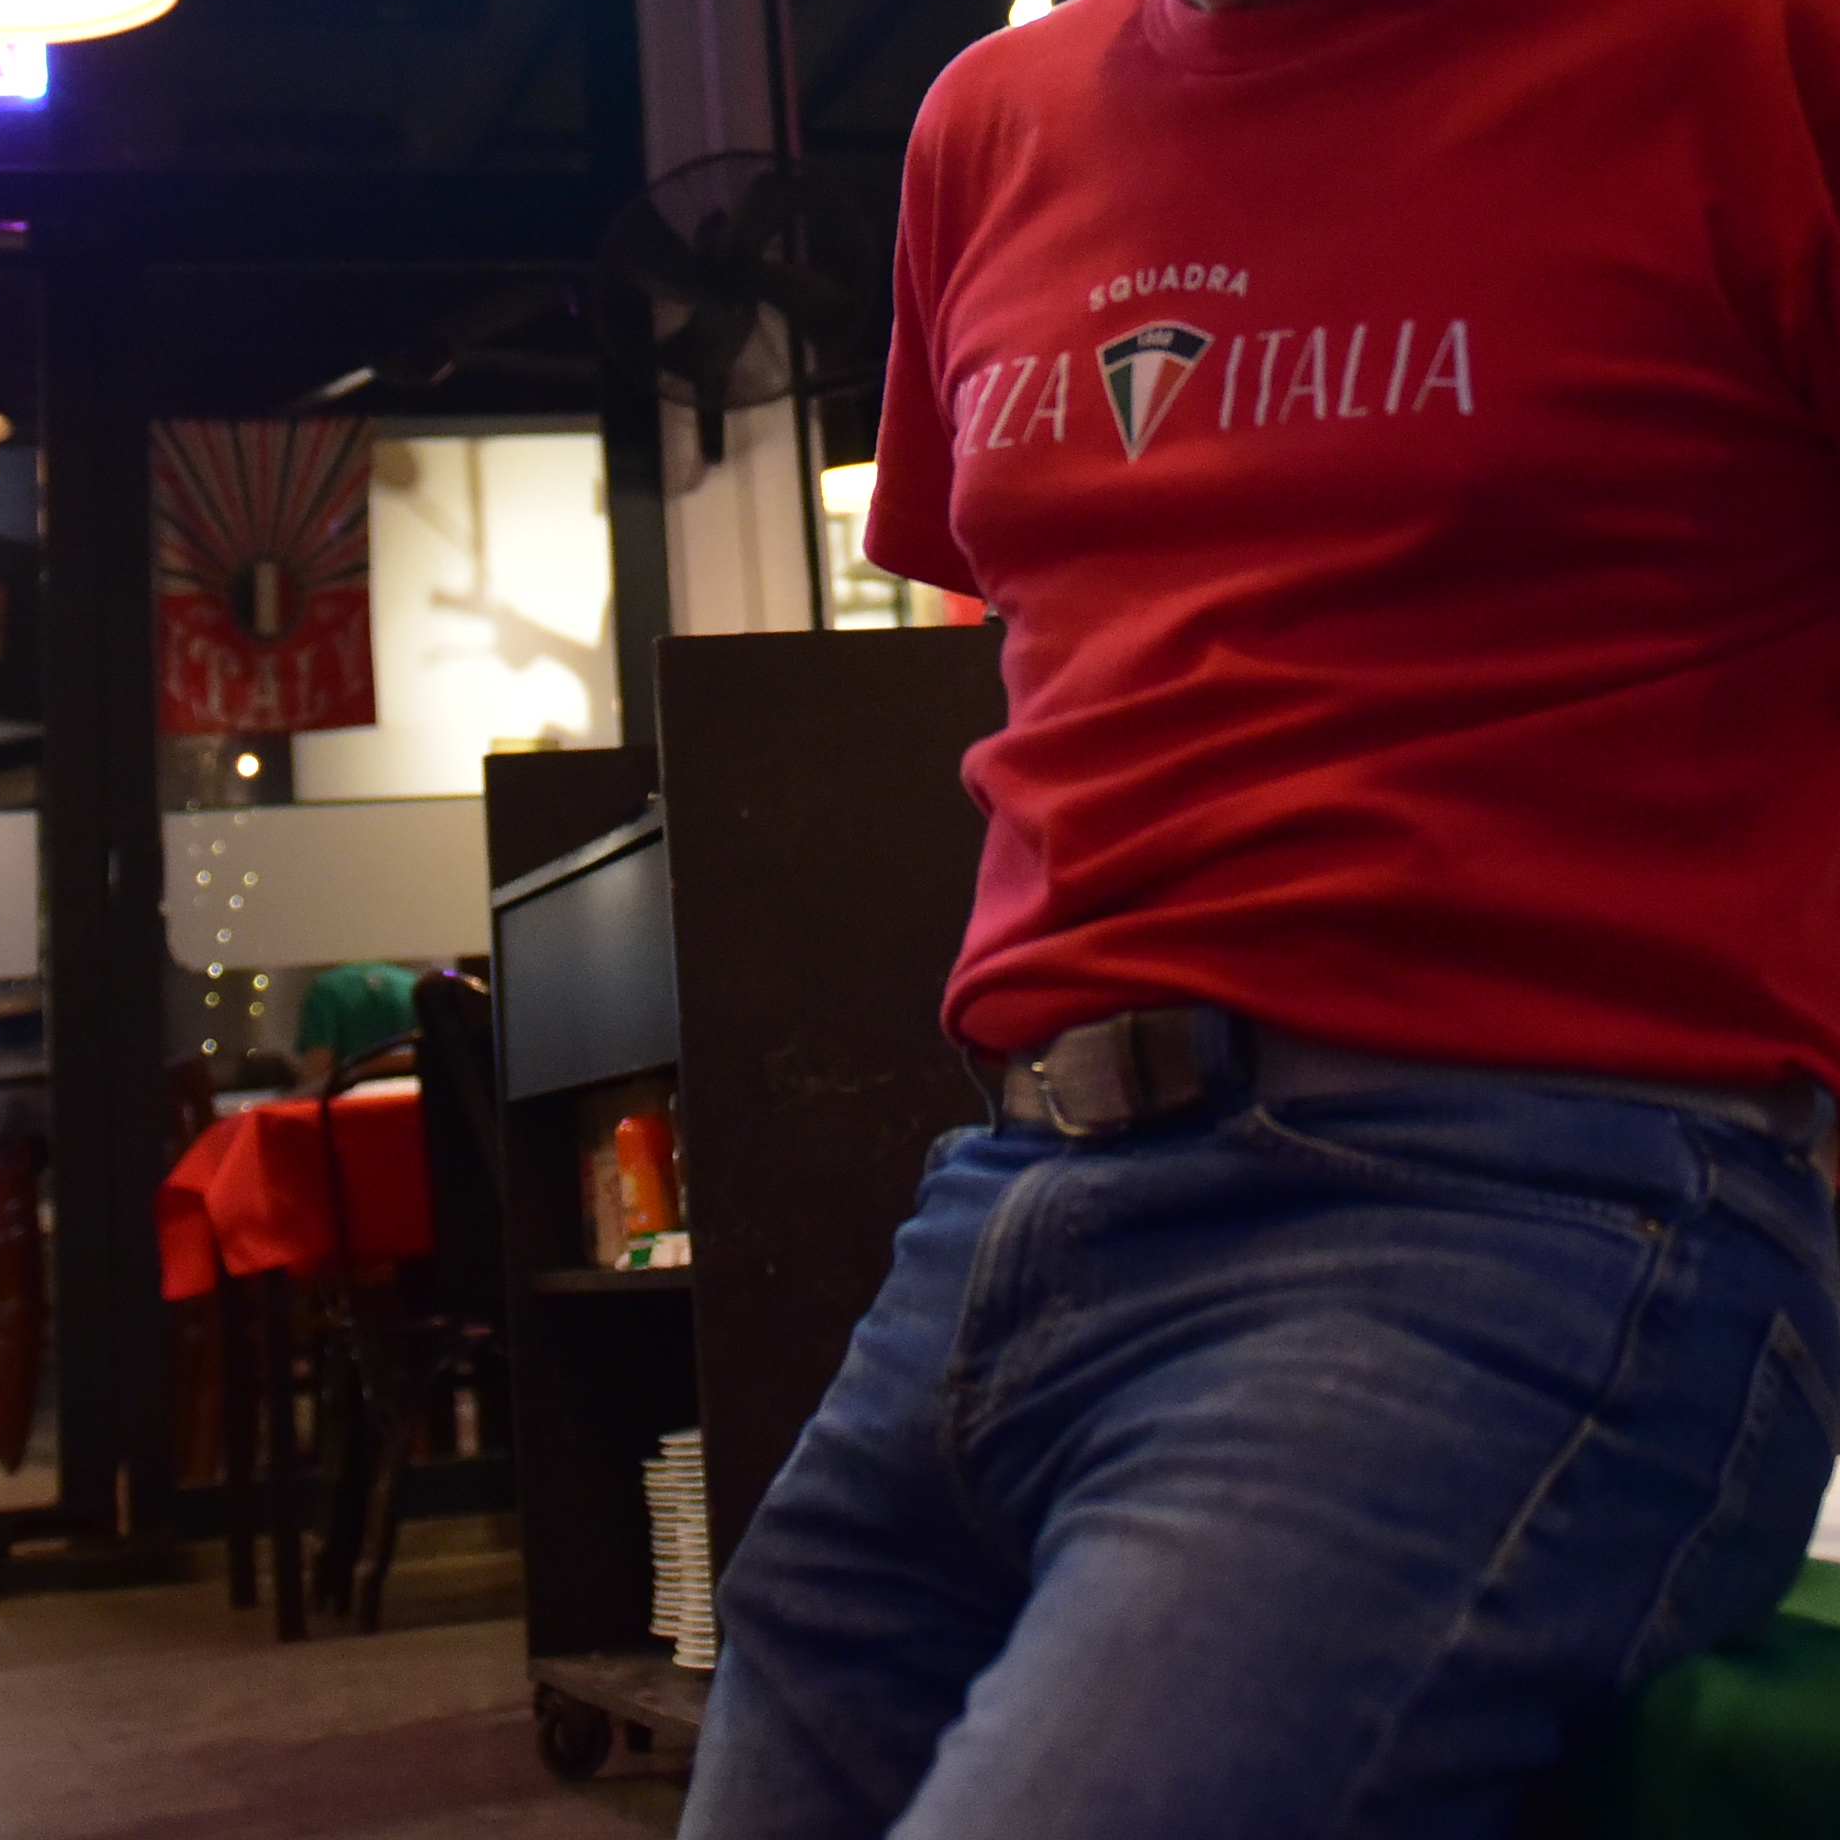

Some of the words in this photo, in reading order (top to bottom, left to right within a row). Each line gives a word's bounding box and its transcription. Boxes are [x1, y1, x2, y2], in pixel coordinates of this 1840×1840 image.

[1089, 263, 1250, 312] SQUADRA
[955, 351, 1071, 455] IZZA
[1218, 318, 1474, 431] ITALIA
